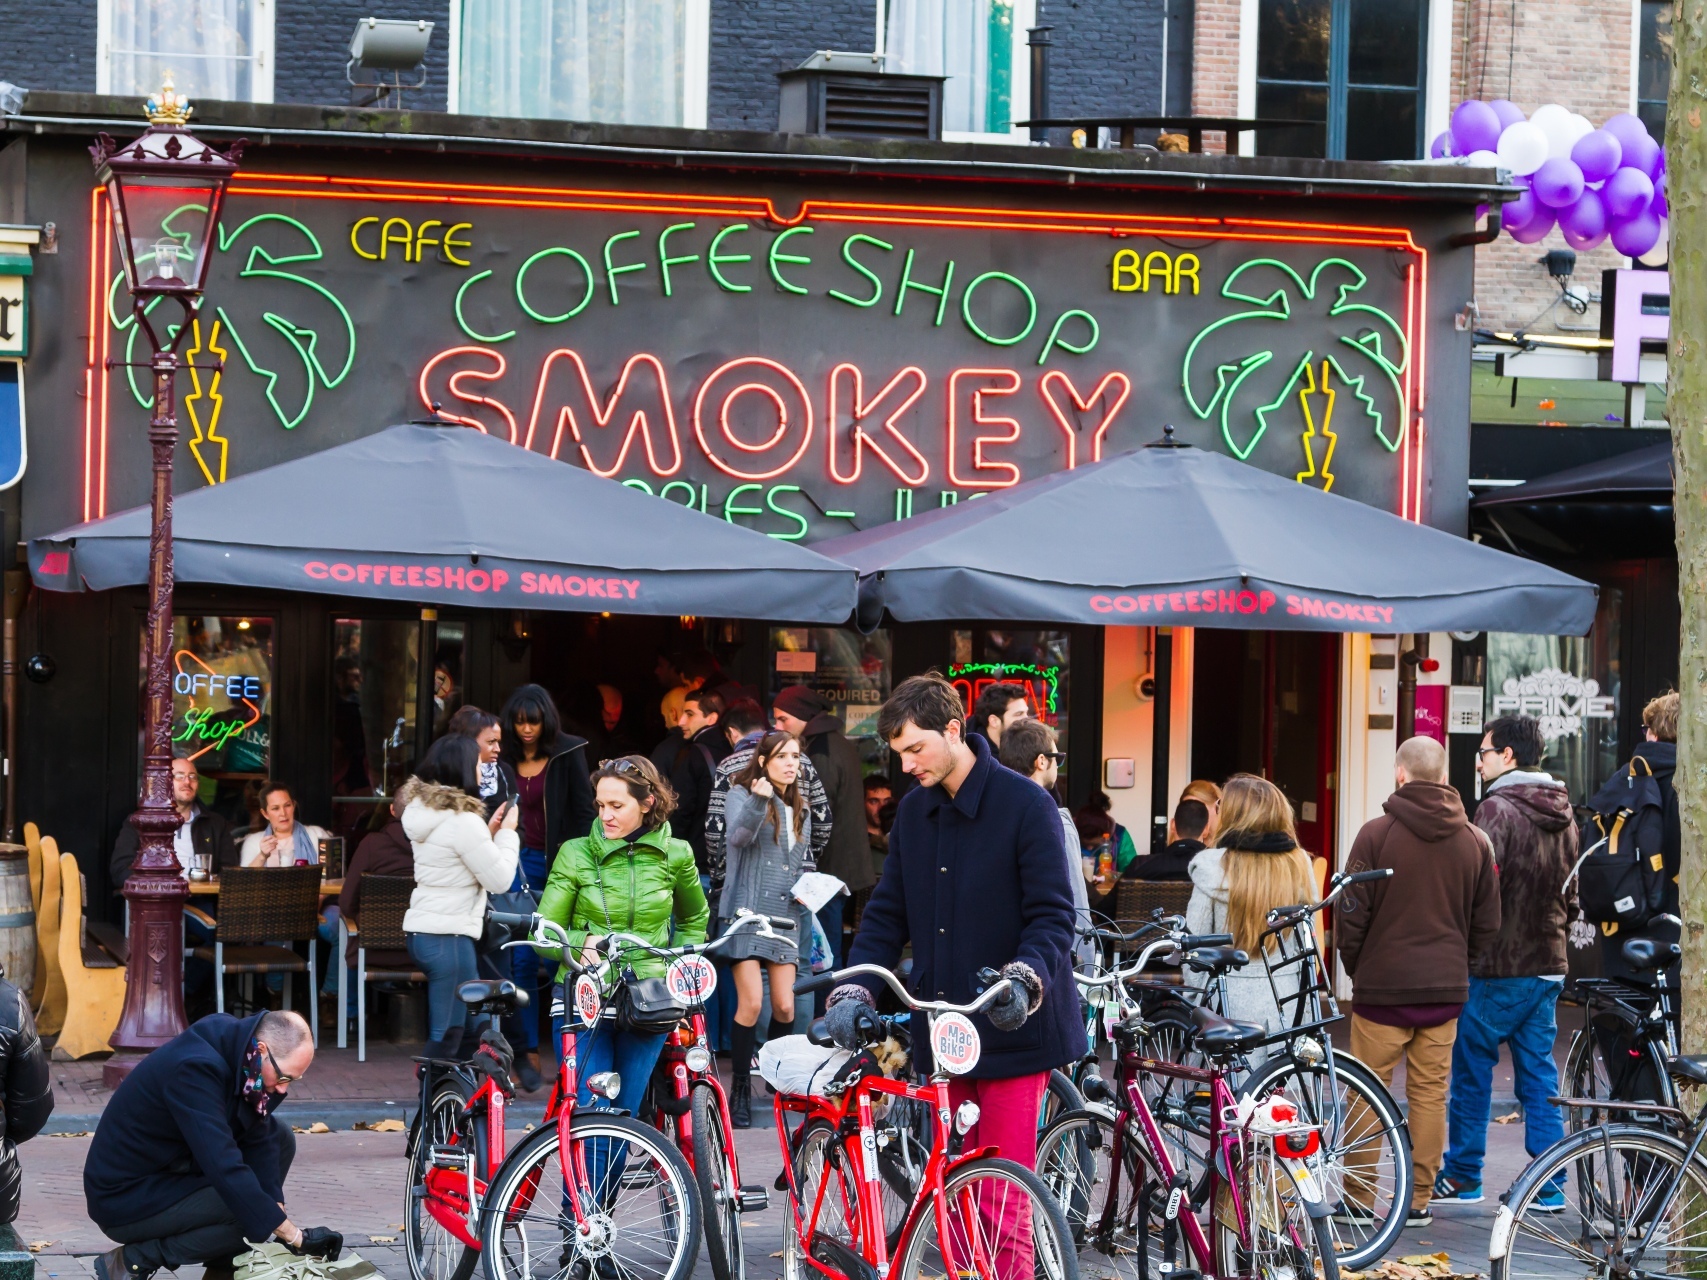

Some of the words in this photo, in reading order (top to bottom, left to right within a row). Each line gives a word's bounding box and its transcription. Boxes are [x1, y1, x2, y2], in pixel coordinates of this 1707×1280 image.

[350, 216, 472, 267] CAFE
[1111, 248, 1200, 295] BAR
[455, 222, 1100, 365] COFFEESHOP
[419, 345, 1131, 486] SMOKEY
[303, 561, 509, 592] COFFEESHOP
[520, 571, 640, 599] SMOKEY
[1089, 590, 1276, 614] COFFEESHOP
[1286, 597, 1394, 623] SMOKEY
[174, 672, 260, 698] OFFEE
[816, 689, 881, 702] EQUIRED
[1492, 696, 1615, 718] PRIME
[171, 706, 245, 751] Shop
[682, 965, 708, 978] Mac
[583, 985, 597, 1005] Mac
[676, 977, 702, 993] Bike
[580, 994, 593, 1015] Bike
[940, 1036, 965, 1058] Bike
[948, 1024, 973, 1047] Mac
[1168, 1192, 1181, 1215] ABUS
